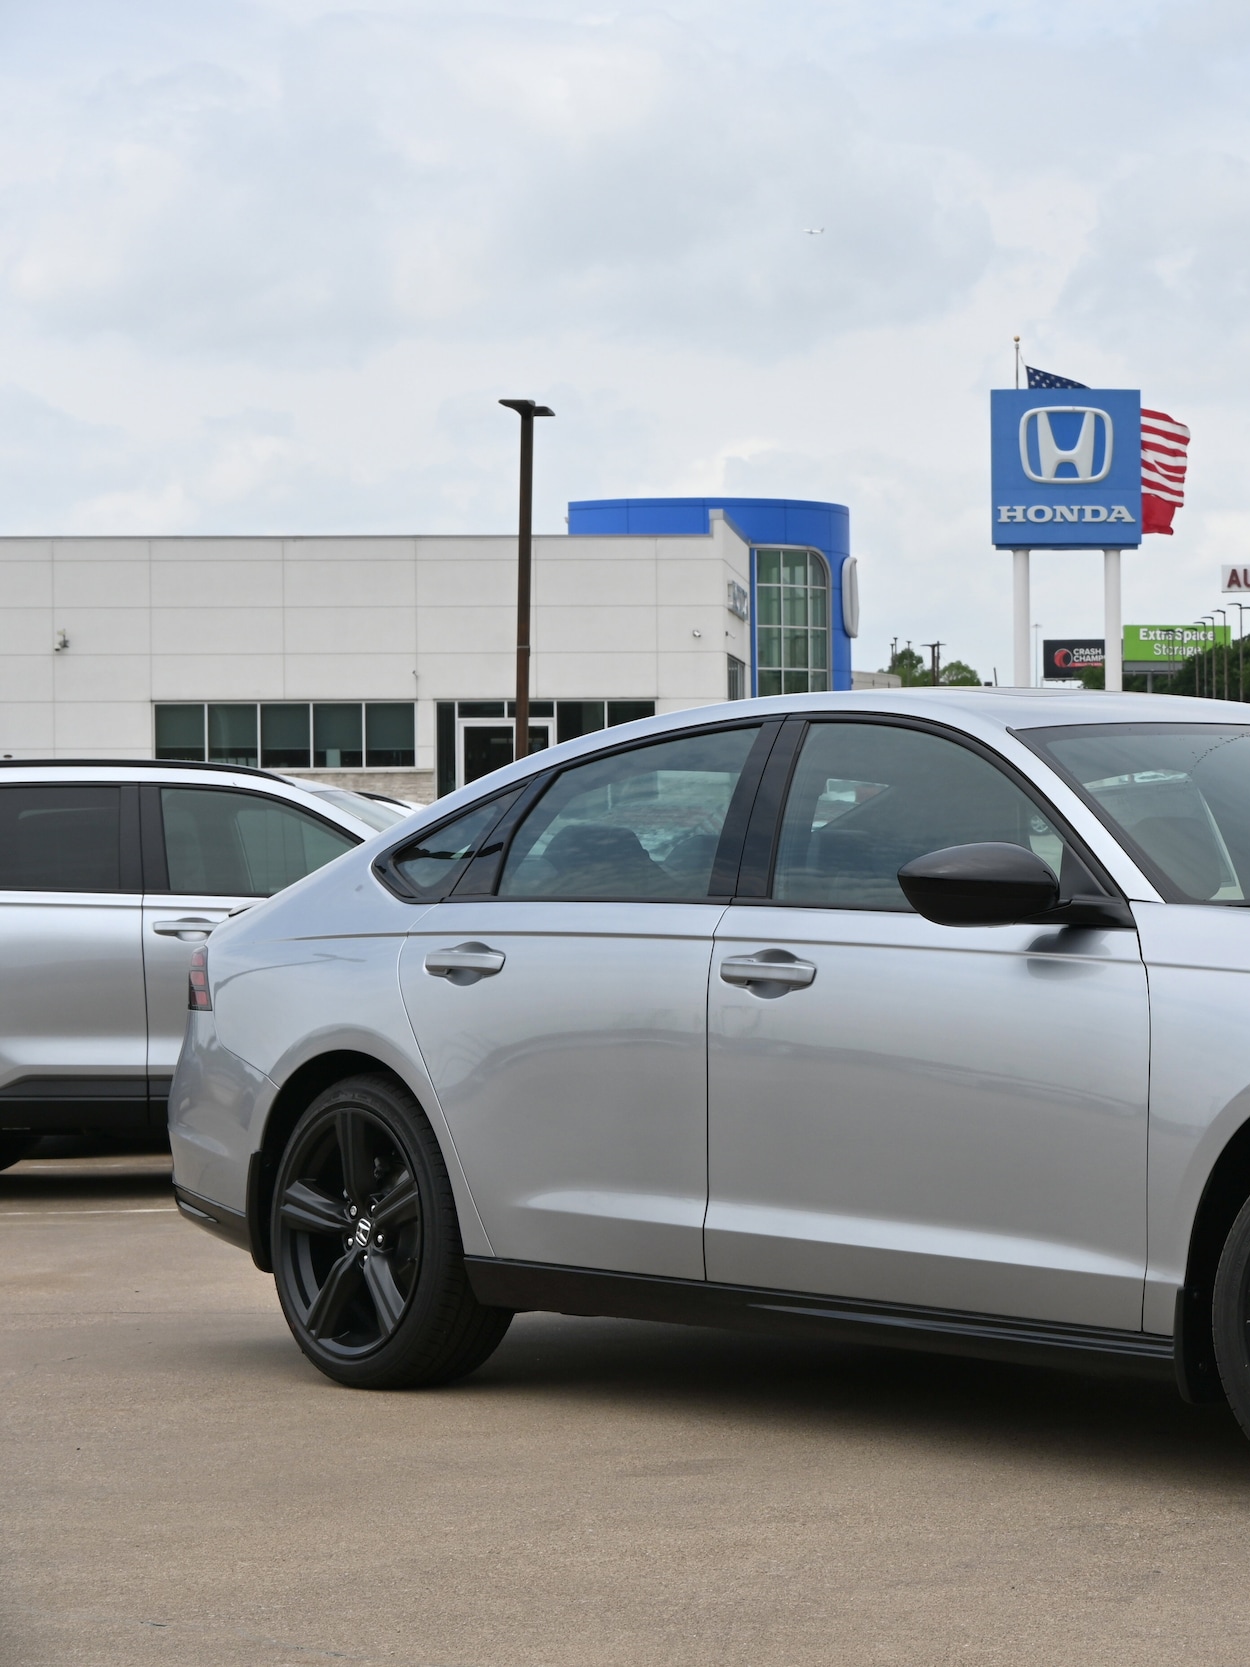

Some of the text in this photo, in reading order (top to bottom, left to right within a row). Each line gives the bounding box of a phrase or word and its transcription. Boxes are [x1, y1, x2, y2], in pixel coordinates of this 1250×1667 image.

[997, 505, 1136, 523] HONDA
[1139, 627, 1214, 643] Extra Space
[1153, 643, 1202, 657] Storage
